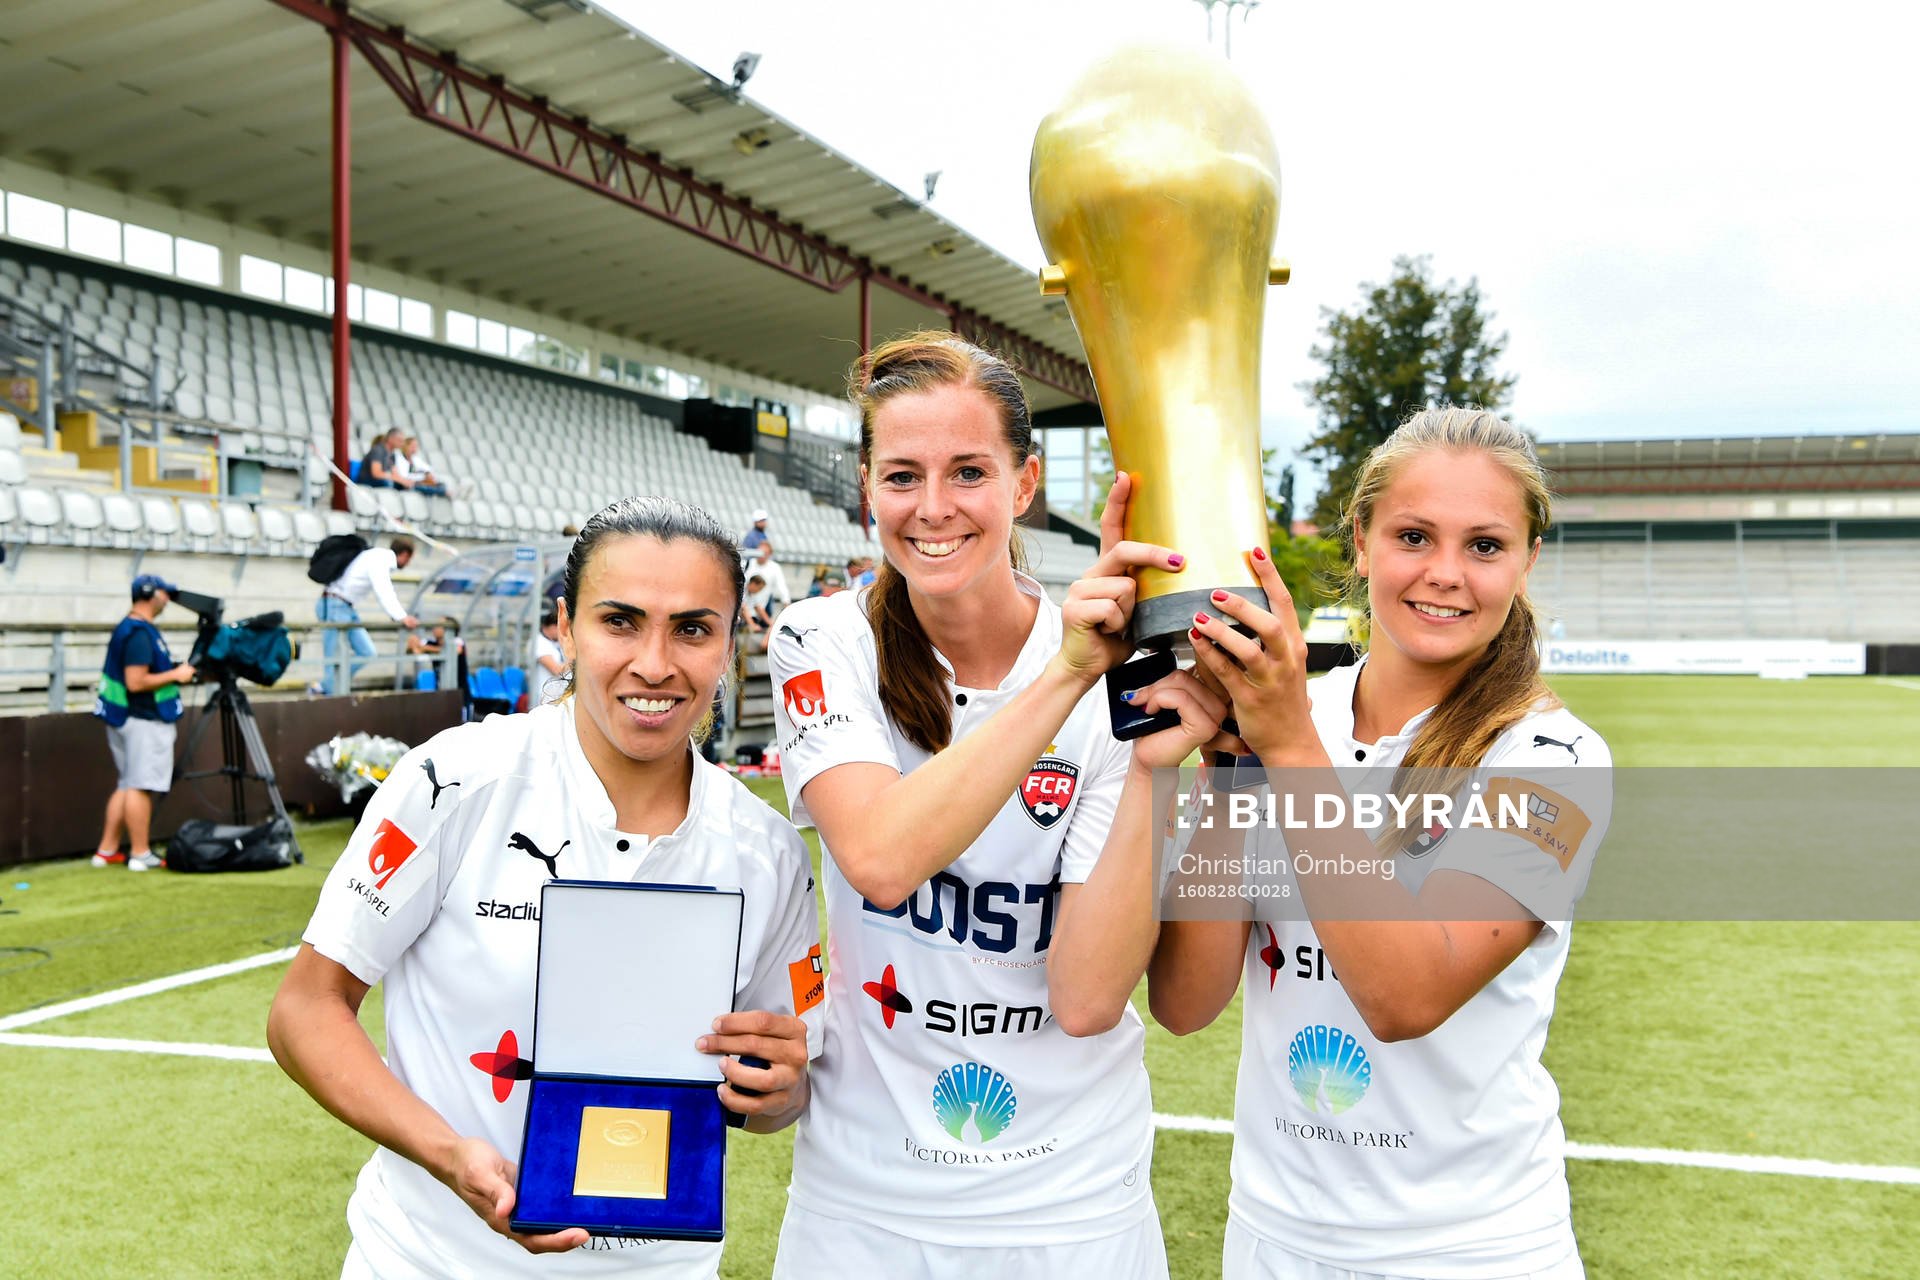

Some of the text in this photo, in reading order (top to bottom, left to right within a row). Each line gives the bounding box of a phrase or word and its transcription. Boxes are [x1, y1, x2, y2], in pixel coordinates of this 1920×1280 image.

[823, 714, 853, 729] SPEL
[1025, 776, 1071, 794] FCR
[1490, 813, 1569, 856] SOE & SAVE
[985, 957, 995, 966] FC
[1296, 946, 1338, 981] SI
[926, 1000, 1053, 1036] SIGM
[905, 1138, 995, 1164] VICTORIA
